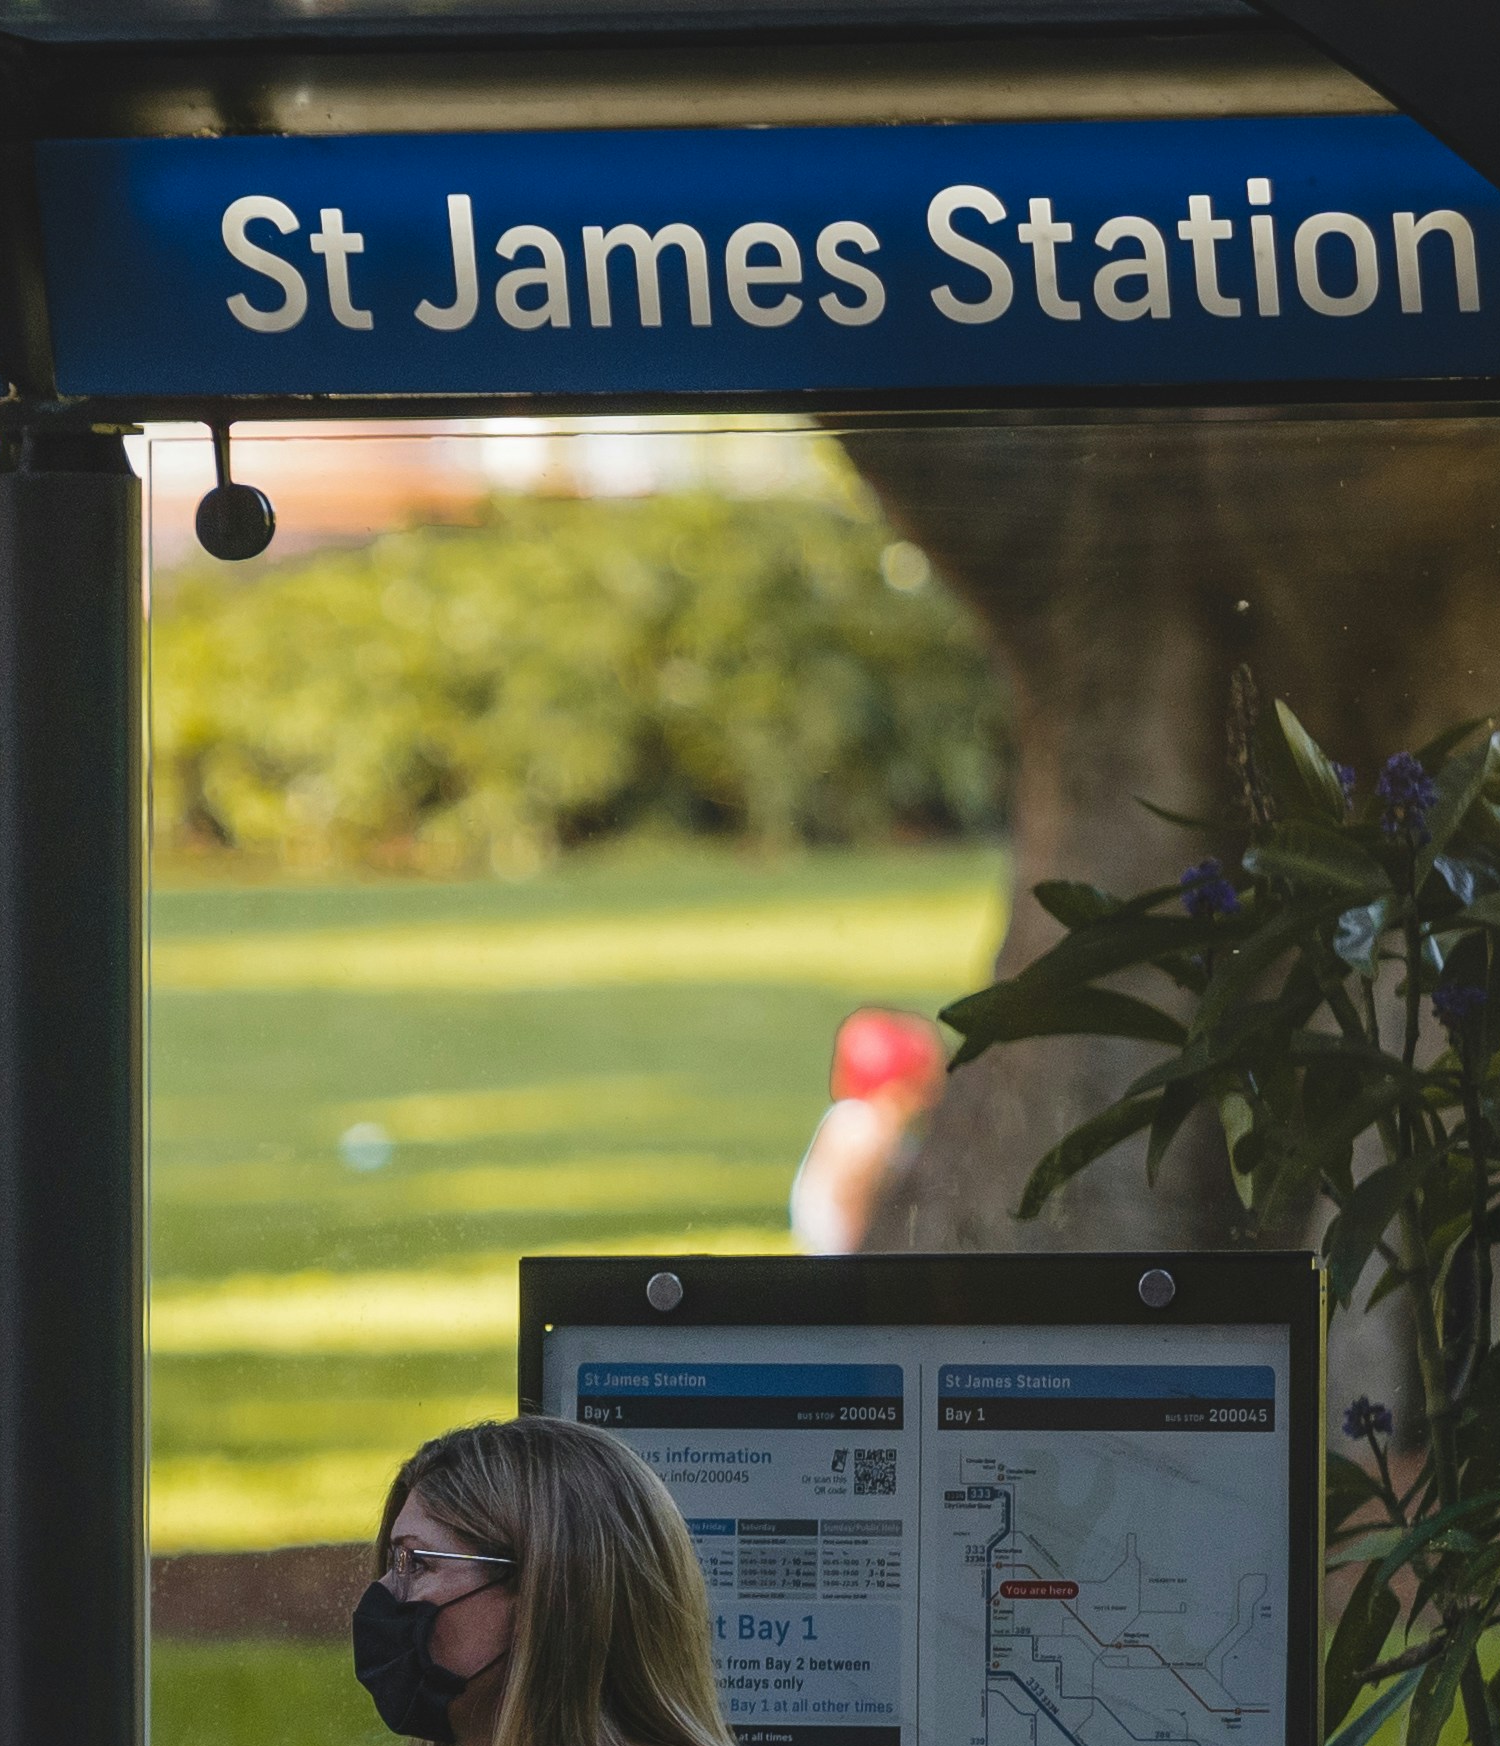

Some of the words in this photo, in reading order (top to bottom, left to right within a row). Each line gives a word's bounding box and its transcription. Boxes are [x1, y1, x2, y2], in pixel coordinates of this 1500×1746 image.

[222, 196, 372, 331] St
[415, 194, 885, 330] James
[927, 178, 1478, 323] Station
[585, 1373, 598, 1387] St
[604, 1373, 649, 1387] James
[654, 1373, 707, 1387] Station
[945, 1375, 960, 1388] St
[965, 1375, 1012, 1388] James
[1017, 1375, 1071, 1388] Station
[584, 1406, 611, 1423] Bay
[615, 1406, 623, 1420] 1
[797, 1412, 813, 1421] BUS
[815, 1412, 836, 1421] STOP
[839, 1406, 897, 1421] 200045
[945, 1408, 972, 1423] Bay
[977, 1408, 986, 1421] 1
[1165, 1414, 1181, 1422] BUS
[1183, 1414, 1206, 1422] STOP
[1209, 1408, 1269, 1422] 200045
[666, 1447, 772, 1464] information
[801, 1474, 812, 1484] Or
[814, 1476, 831, 1484] scan
[833, 1474, 848, 1484] this
[814, 1486, 826, 1496] QR
[828, 1486, 848, 1495] code
[970, 1488, 992, 1498] 333
[702, 1523, 728, 1534] Friday
[740, 1522, 776, 1534] Saturday
[965, 1544, 985, 1554] 333
[1005, 1585, 1027, 1596] You
[1029, 1587, 1048, 1596] are
[1049, 1585, 1074, 1596] here
[739, 1614, 791, 1647] Bay
[802, 1615, 819, 1641] 1
[727, 1656, 761, 1671] from
[765, 1657, 792, 1674] Bay
[796, 1657, 805, 1671] 2
[809, 1657, 871, 1672] between
[773, 1675, 804, 1692] only
[1026, 1676, 1046, 1698] 333
[731, 1699, 757, 1715] Bay
[761, 1699, 770, 1712] 1
[774, 1700, 788, 1712] at
[792, 1699, 808, 1712] all
[812, 1699, 850, 1713] other
[854, 1700, 894, 1714] times
[738, 1731, 749, 1742] at
[751, 1730, 764, 1742] all
[766, 1731, 794, 1742] times
